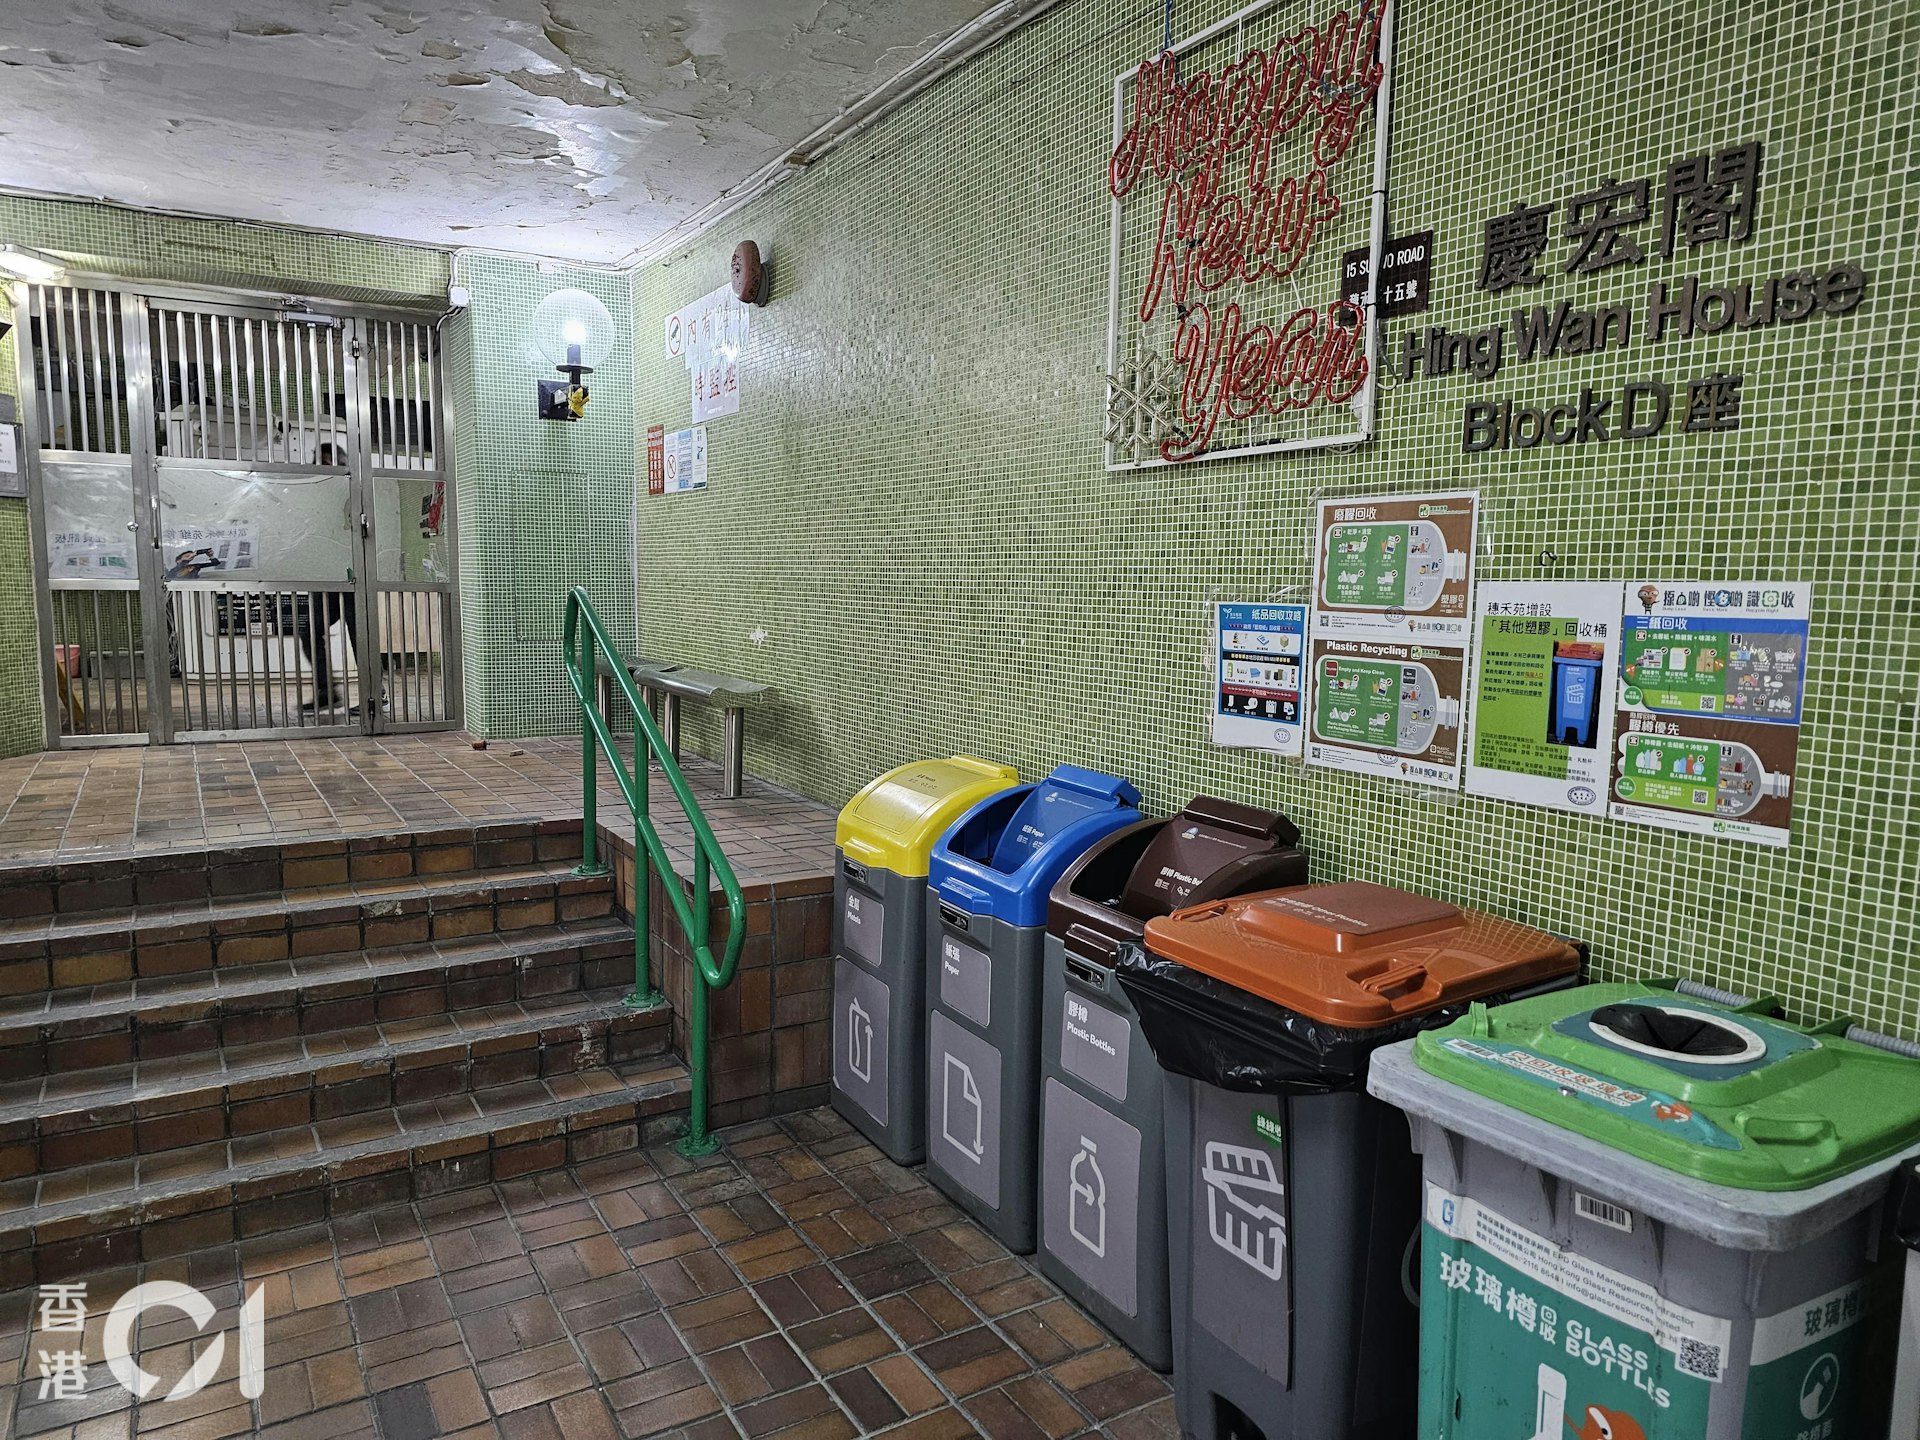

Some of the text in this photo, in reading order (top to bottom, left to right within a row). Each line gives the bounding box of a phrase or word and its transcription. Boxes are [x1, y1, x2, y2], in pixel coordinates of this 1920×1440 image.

[1111, 0, 1384, 197] Happy
[1476, 141, 1762, 291] 慶宏閣
[1141, 169, 1340, 322] New
[1346, 262, 1357, 278] 15
[1383, 253, 1394, 269] O
[1397, 246, 1425, 266] ROAD
[1403, 262, 1867, 381] Hing Wan House
[1161, 300, 1367, 462] Year
[1463, 373, 1744, 452] Block D 座
[1334, 507, 1377, 521] 廢膠回收
[1252, 609, 1301, 621] 紙品回收攻略
[1487, 602, 1552, 617] 穗禾苑增設
[1636, 616, 1688, 630] 三紙回收
[1491, 619, 1608, 638] 「其他塑膠」回收桶
[1326, 641, 1408, 657] Plastic Recycling
[1628, 719, 1680, 735] 膠樽優先
[1173, 871, 1193, 884] Plastic
[944, 960, 960, 976] Paper
[945, 942, 961, 962] 紙張
[1068, 1000, 1088, 1023] 膠樽
[1066, 1021, 1116, 1056] Plastic Bottles
[1440, 1251, 1538, 1333] 玻璃樽
[1538, 1254, 1558, 1270] Hong
[1559, 1263, 1581, 1283] Kong
[1582, 1276, 1606, 1294] Glass
[1608, 1287, 1654, 1315] Resources
[1552, 1250, 1570, 1264] EPD
[1571, 1259, 1595, 1276] Glass
[1596, 1271, 1654, 1302] Management
[1539, 1305, 1558, 1345] 回收
[1566, 1319, 1649, 1371] GLASS
